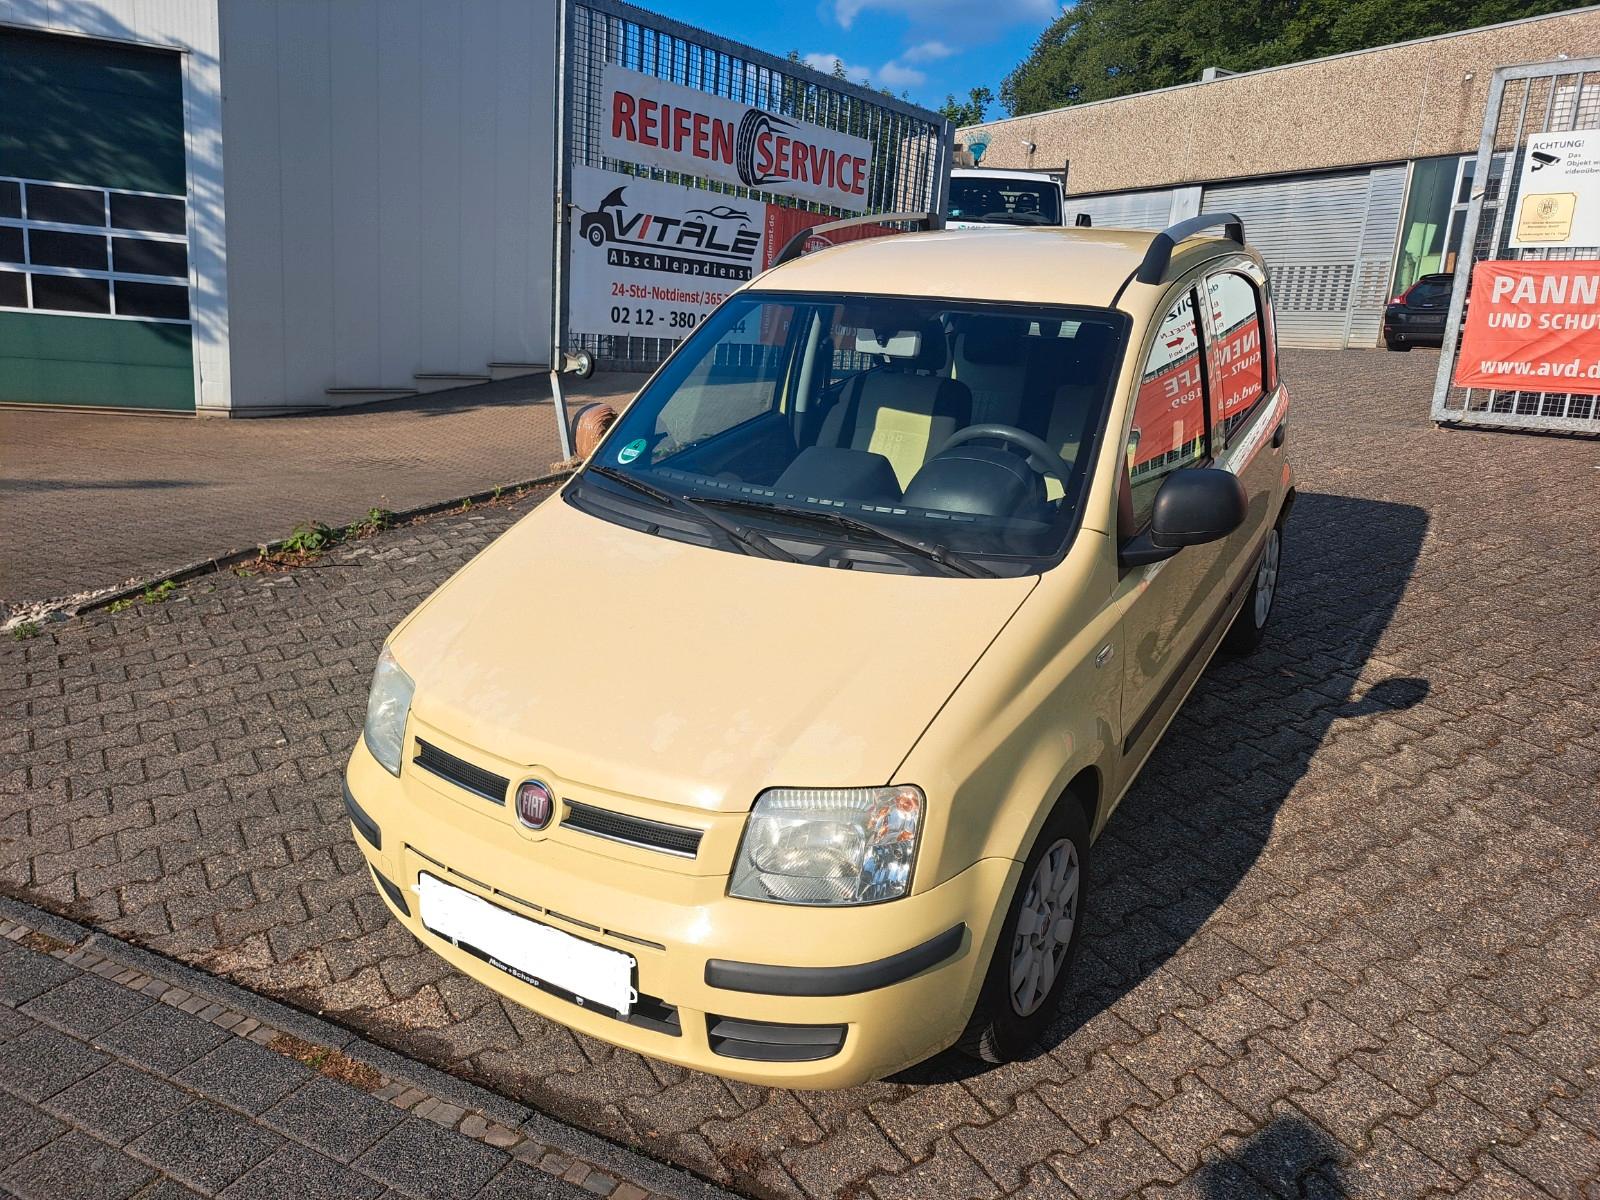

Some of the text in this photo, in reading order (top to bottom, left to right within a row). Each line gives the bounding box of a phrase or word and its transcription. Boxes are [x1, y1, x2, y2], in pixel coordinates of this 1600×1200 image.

[611, 90, 868, 196] REIFEN SERVICE
[1532, 140, 1585, 151] ACHTUNG!
[1566, 160, 1592, 168] Objekt
[614, 210, 762, 255] VITALE
[609, 250, 752, 279] Abschleppdienst
[611, 282, 722, 306] 24-Std-Notdienst/365
[1491, 275, 1600, 304] PANN
[610, 306, 630, 324] 02
[635, 308, 654, 326] 12
[669, 311, 696, 329] 380
[1488, 312, 1532, 329] UND
[522, 792, 547, 818] FIAT
